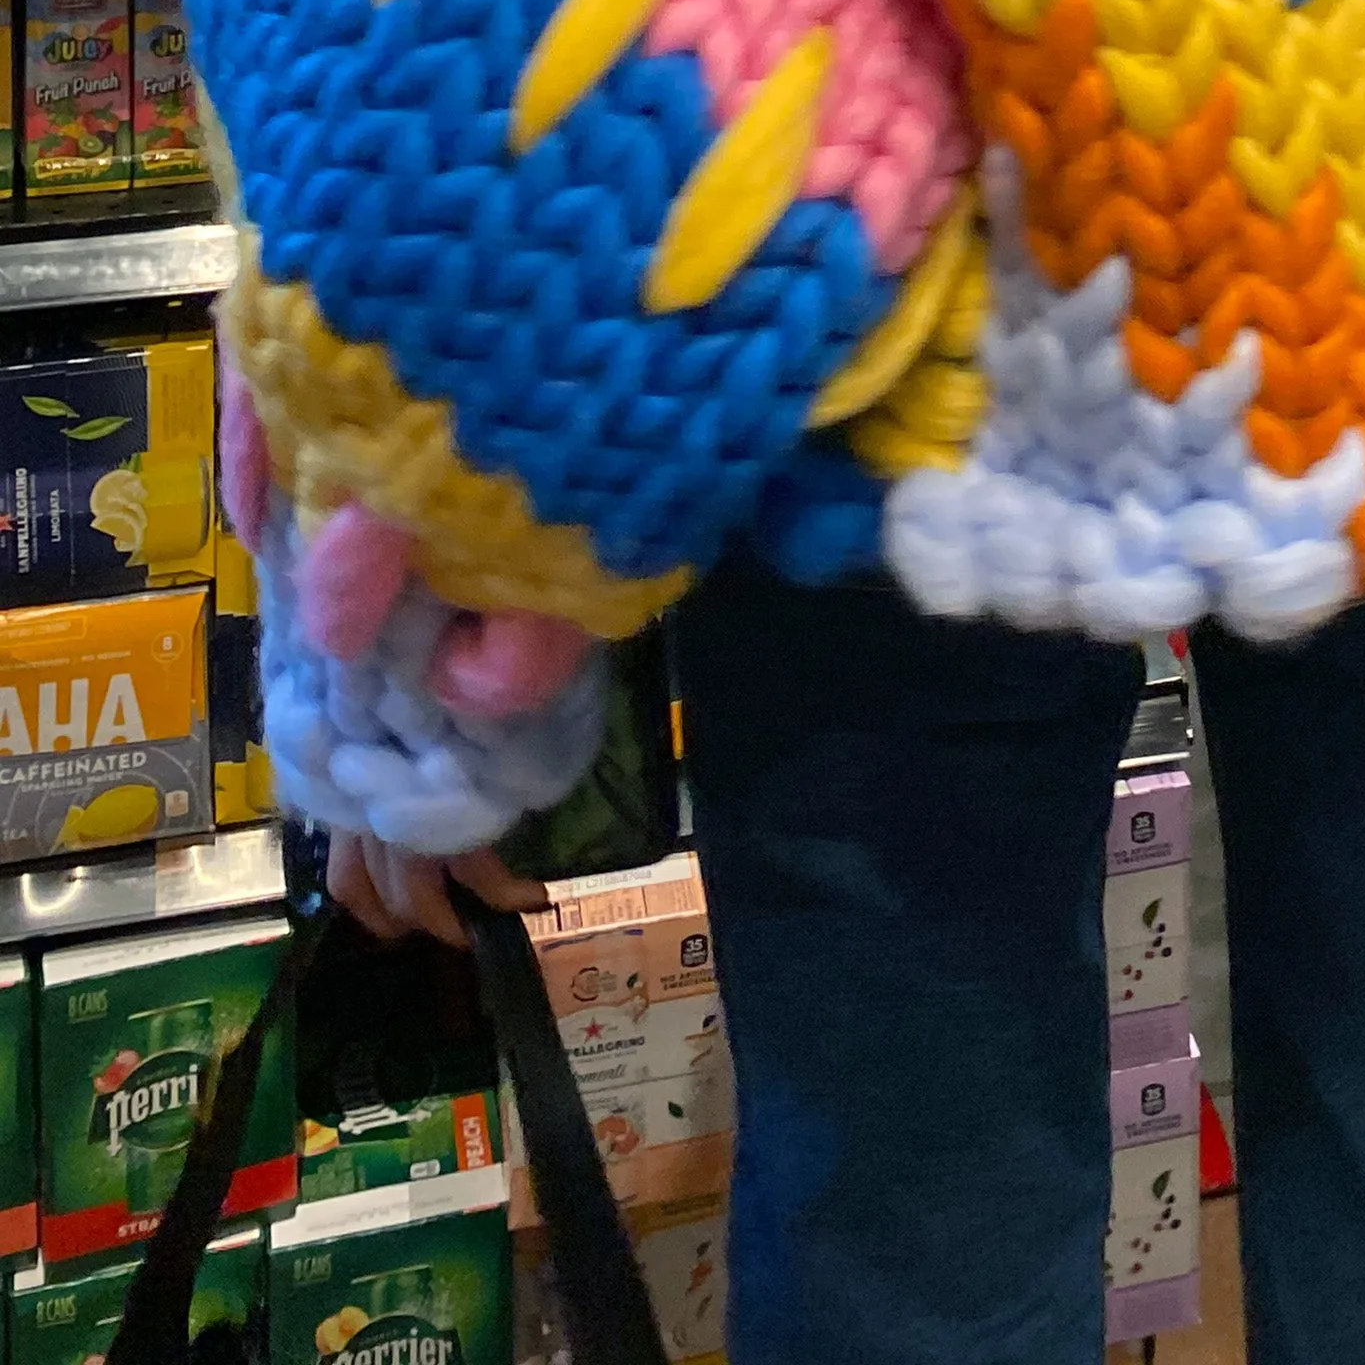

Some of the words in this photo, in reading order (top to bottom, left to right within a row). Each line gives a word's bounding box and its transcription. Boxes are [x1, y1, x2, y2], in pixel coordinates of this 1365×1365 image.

[36, 81, 69, 105] Fruit
[73, 70, 120, 98] Punch
[143, 77, 177, 99] Fruit
[16, 467, 29, 574] SANPELLEGRINO
[0, 672, 148, 759] AHA
[0, 751, 149, 785] CAFFEINATED
[462, 1115, 486, 1169] PEACH
